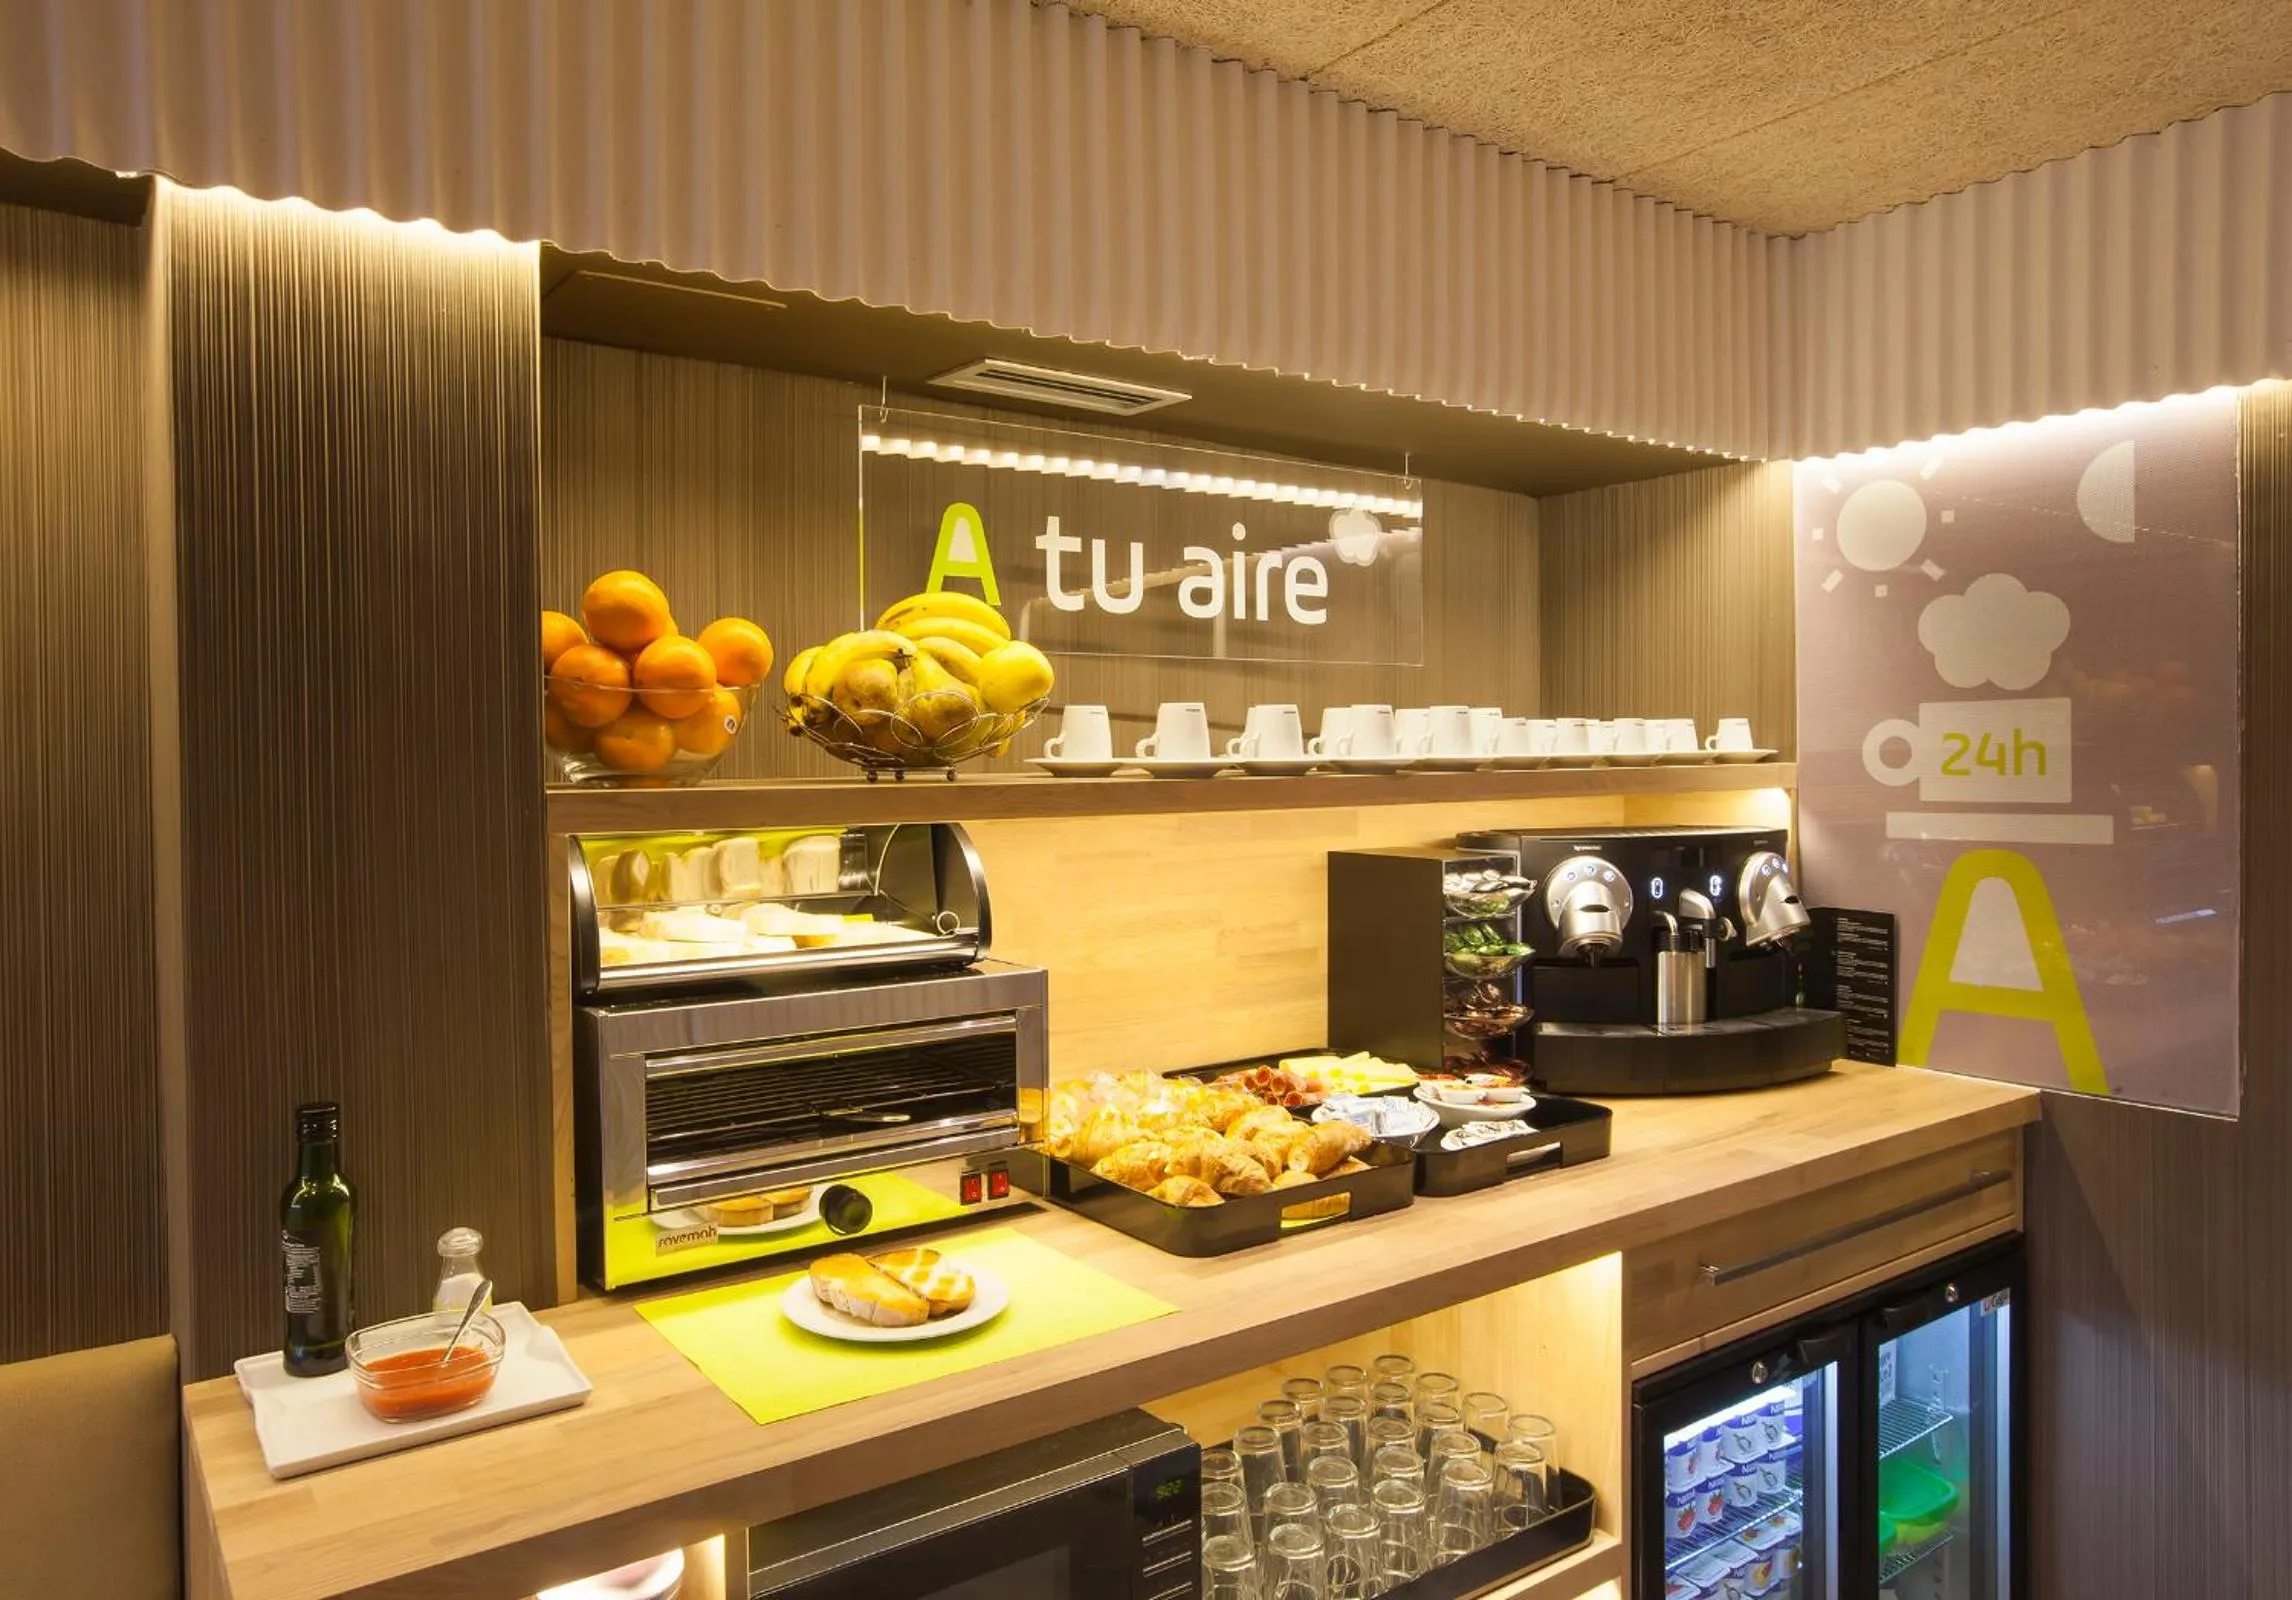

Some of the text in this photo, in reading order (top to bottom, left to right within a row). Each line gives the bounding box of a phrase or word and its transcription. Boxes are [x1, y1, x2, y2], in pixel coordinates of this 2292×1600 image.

[926, 502, 1328, 625] A tu aire
[1940, 728, 2047, 777] 24h
[1898, 849, 2110, 1095] A
